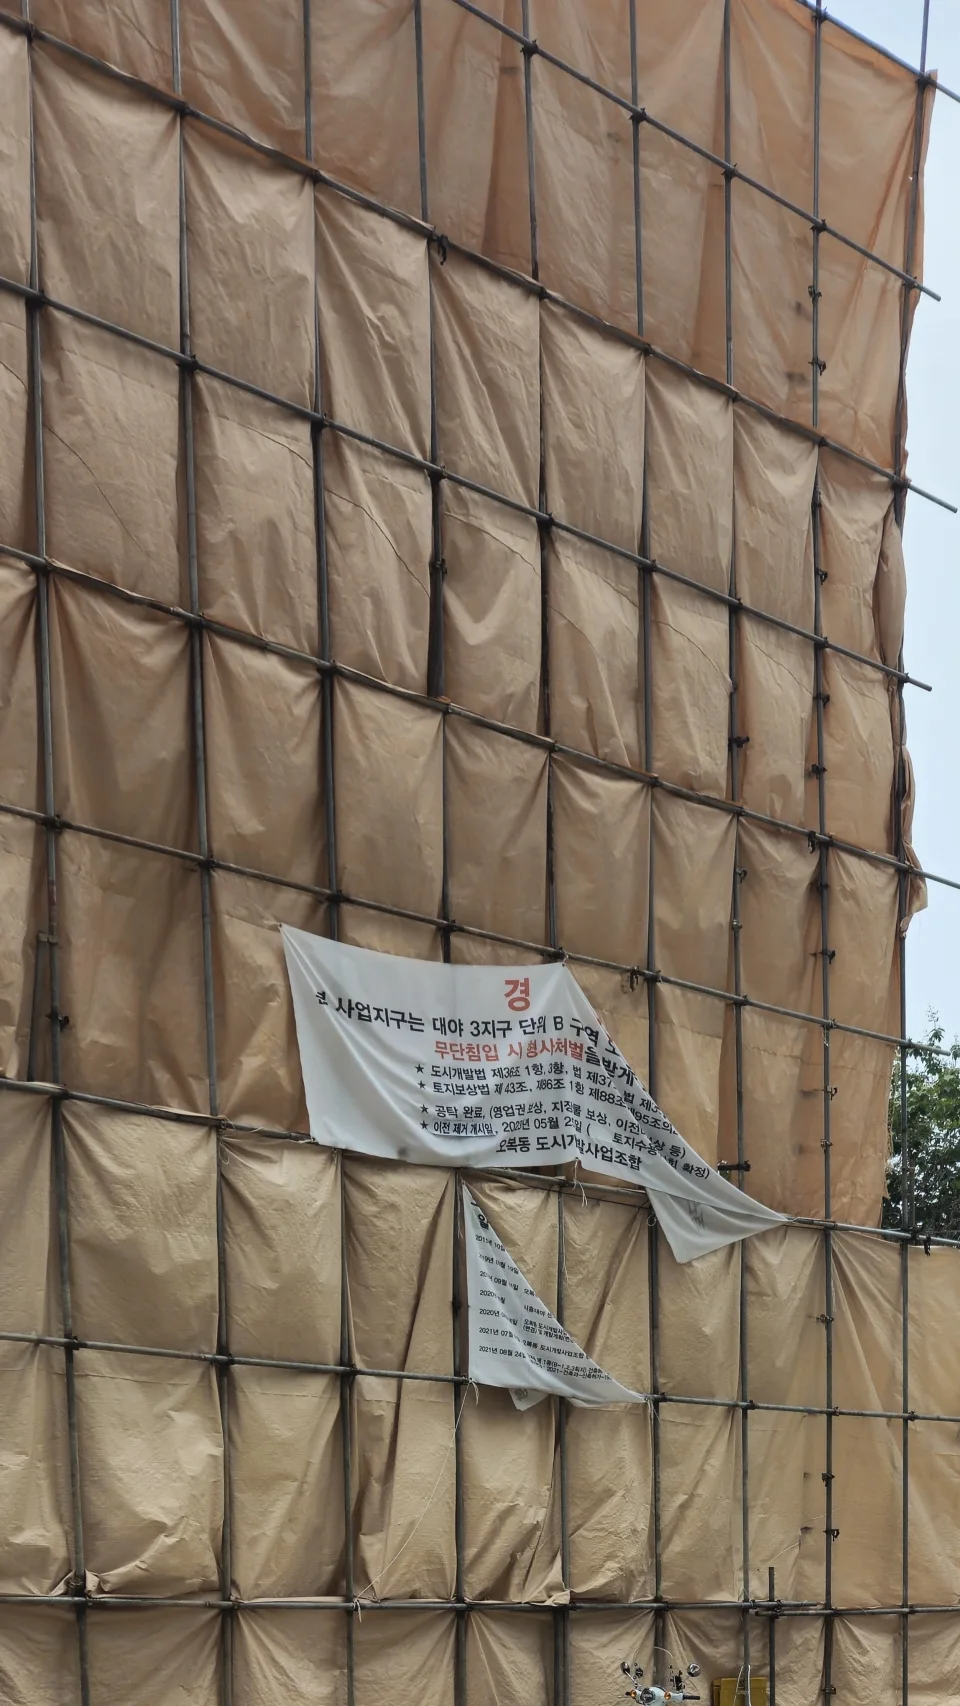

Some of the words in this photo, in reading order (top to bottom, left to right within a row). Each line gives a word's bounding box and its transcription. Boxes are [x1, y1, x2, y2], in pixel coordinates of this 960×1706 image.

[504, 977, 531, 1011] 경
[335, 997, 425, 1033] 사업지구는
[432, 1017, 464, 1038] 대야
[469, 1020, 513, 1039] 3지구
[519, 1017, 546, 1036] 단위
[553, 1015, 564, 1031] B
[569, 1017, 600, 1046] 구역
[434, 1040, 500, 1062] 무단침입
[507, 1044, 523, 1060] 시
[430, 1064, 487, 1081] 도시개발법
[572, 1064, 583, 1079] 법
[433, 1081, 491, 1096] 토지보상법
[435, 1105, 459, 1119] 공탁
[433, 1121, 451, 1135] 이전
[495, 1136, 531, 1154] 오복동
